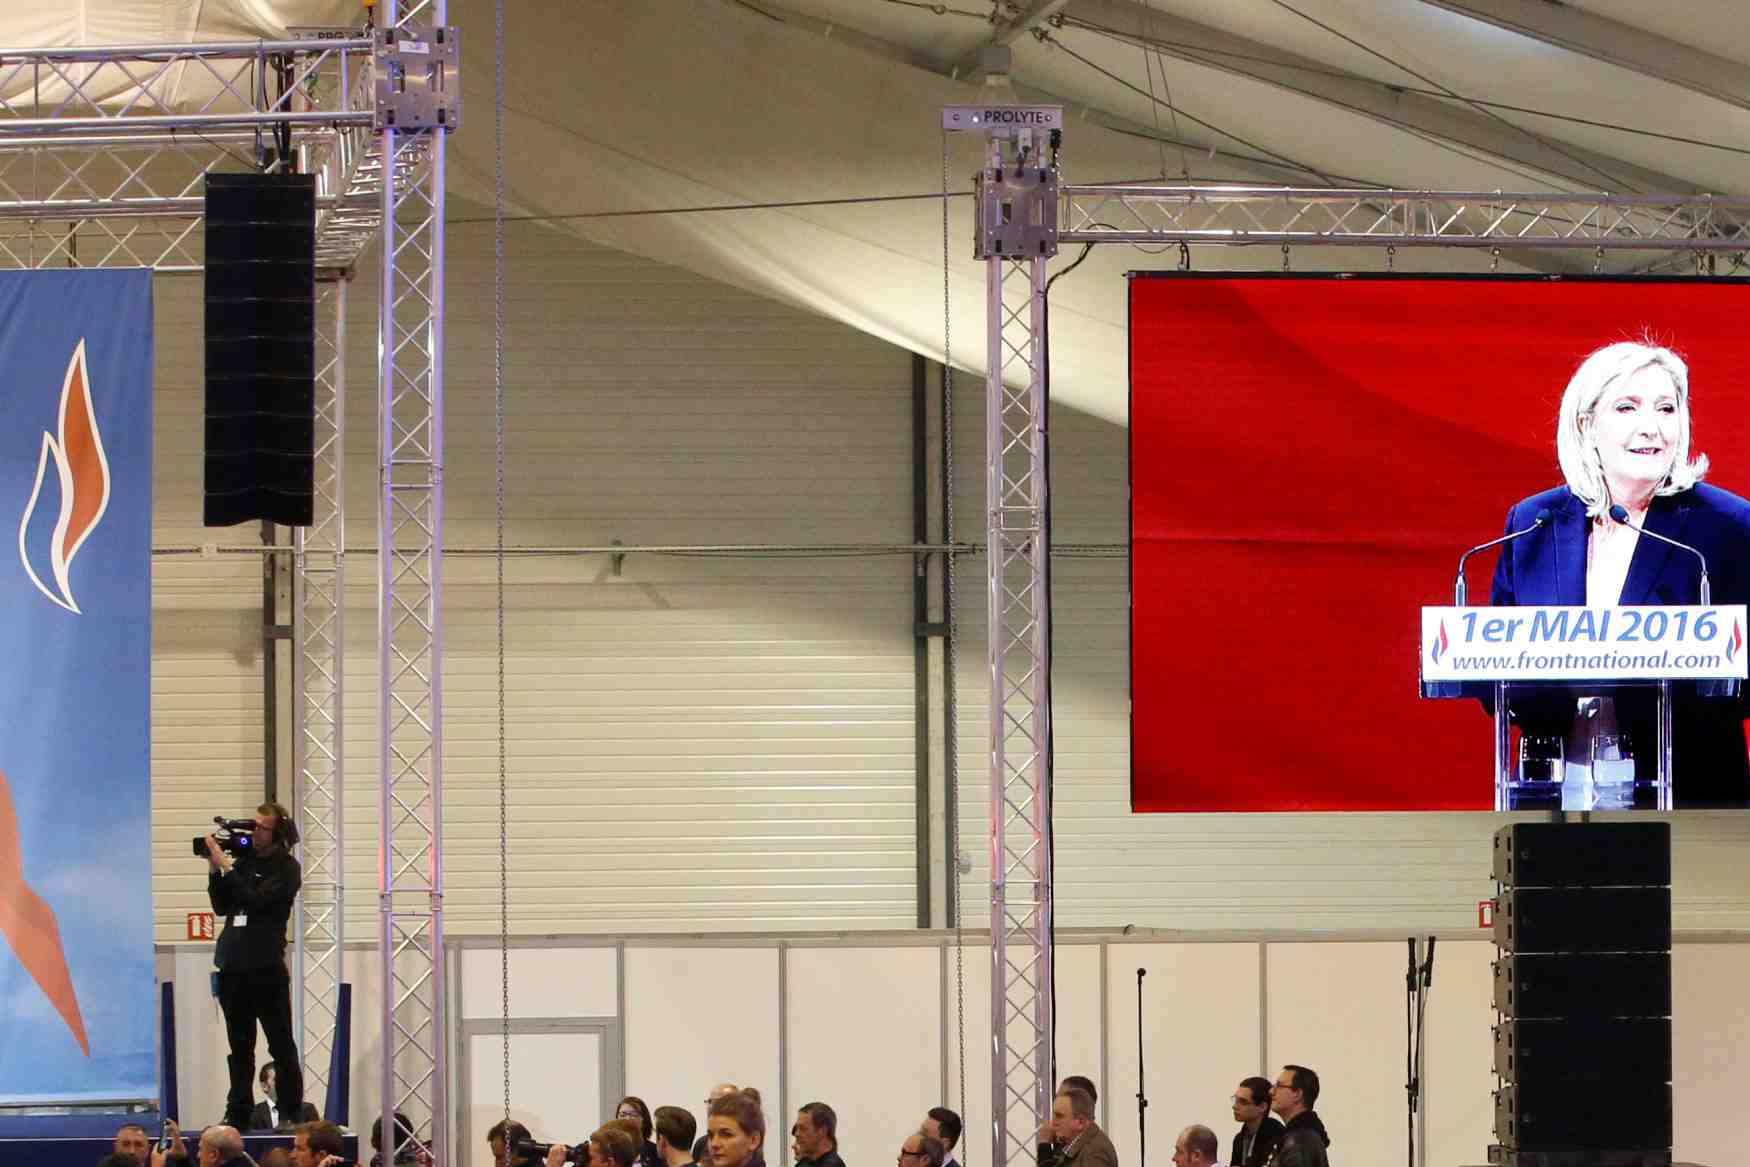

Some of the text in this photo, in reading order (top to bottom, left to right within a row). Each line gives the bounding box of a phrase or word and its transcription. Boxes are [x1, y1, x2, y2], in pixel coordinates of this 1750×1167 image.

[984, 111, 1043, 123] PROLYTE
[1461, 610, 1719, 643] 1er MAI 2016
[1453, 650, 1721, 671] www.frontnational.com
